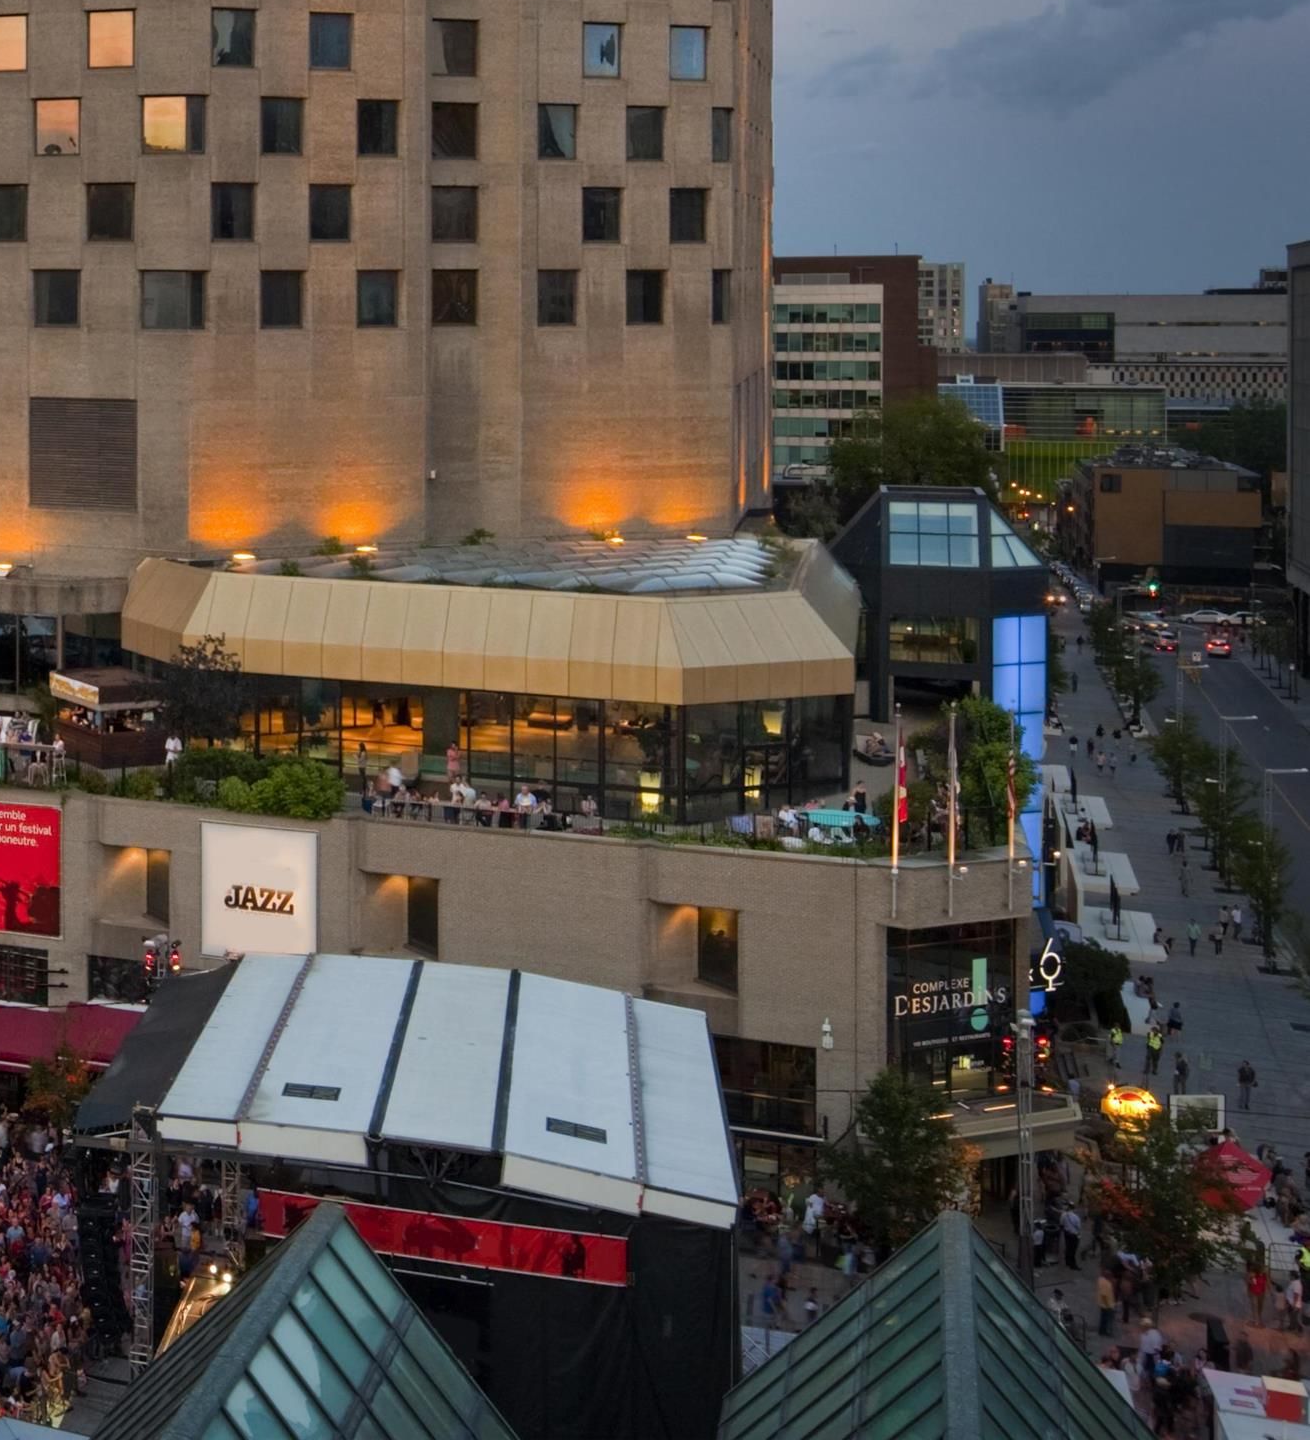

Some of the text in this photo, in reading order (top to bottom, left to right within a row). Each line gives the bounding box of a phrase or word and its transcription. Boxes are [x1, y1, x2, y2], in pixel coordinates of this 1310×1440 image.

[5, 823, 17, 832] un
[19, 822, 52, 836] festival
[224, 885, 294, 915] JAZZ
[912, 977, 971, 995] COMPLEXE
[894, 986, 1007, 1017] DESJARDINS
